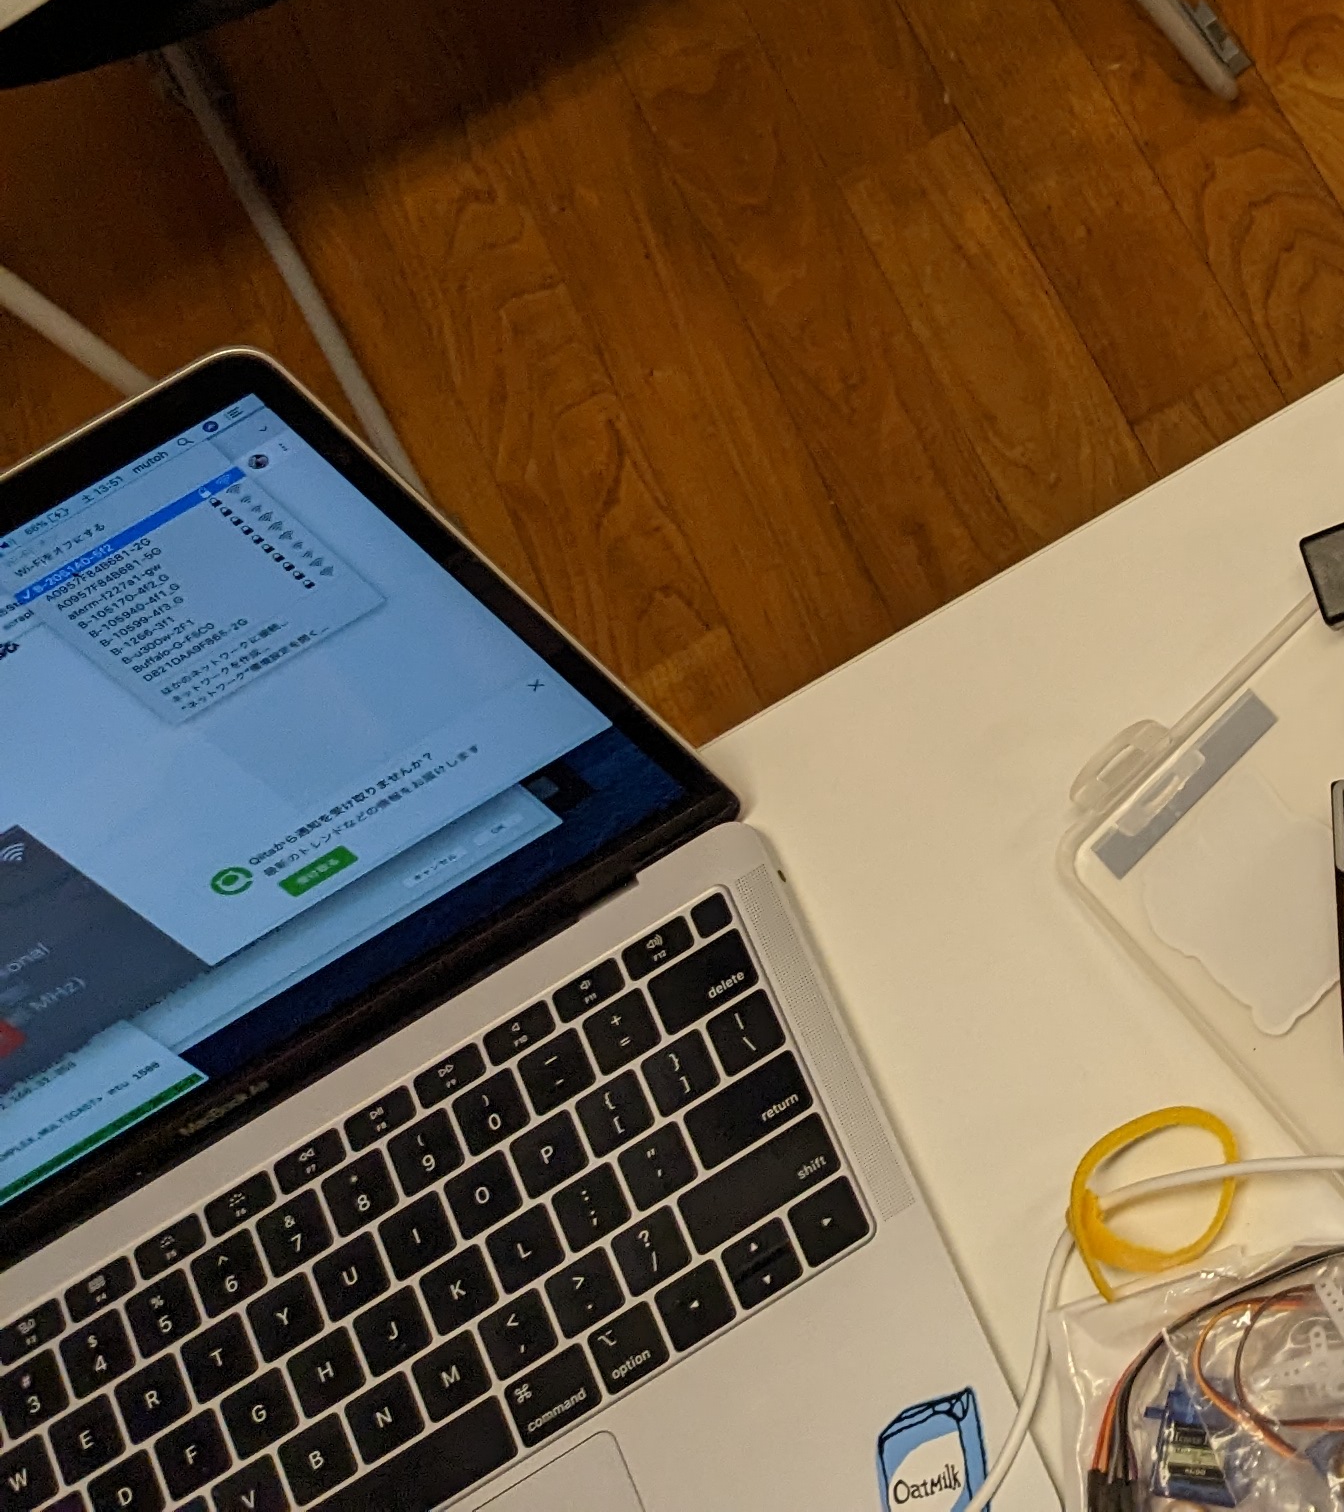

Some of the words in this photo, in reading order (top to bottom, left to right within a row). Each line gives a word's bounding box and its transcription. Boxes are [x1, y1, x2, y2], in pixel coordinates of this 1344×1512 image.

[92, 474, 124, 496] 13:51
[708, 970, 745, 999] delete
[761, 1092, 799, 1122] return
[421, 1153, 436, 1172] 9
[540, 1145, 554, 1164] P
[797, 1155, 827, 1181] shift
[356, 1194, 370, 1211] 8
[291, 1233, 301, 1253] 7
[411, 1228, 422, 1244] I
[517, 1241, 531, 1259] L
[225, 1274, 238, 1293] 6
[342, 1266, 358, 1286] U
[450, 1279, 466, 1300] K
[160, 1315, 172, 1334] 5
[276, 1307, 291, 1327] Y
[388, 1321, 399, 1342] J
[93, 1354, 107, 1373] 4
[210, 1349, 225, 1368] T
[612, 1348, 651, 1381] option
[316, 1362, 334, 1384] H
[440, 1366, 461, 1387] M
[28, 1396, 41, 1414] 3
[145, 1391, 160, 1410] R
[528, 1387, 587, 1433] command
[252, 1404, 267, 1424] G
[376, 1406, 393, 1429] N
[80, 1430, 93, 1449] E
[184, 1445, 198, 1465] F
[308, 1450, 324, 1470] B
[9, 1469, 28, 1491] W
[118, 1487, 133, 1507] D
[241, 1490, 256, 1509] V
